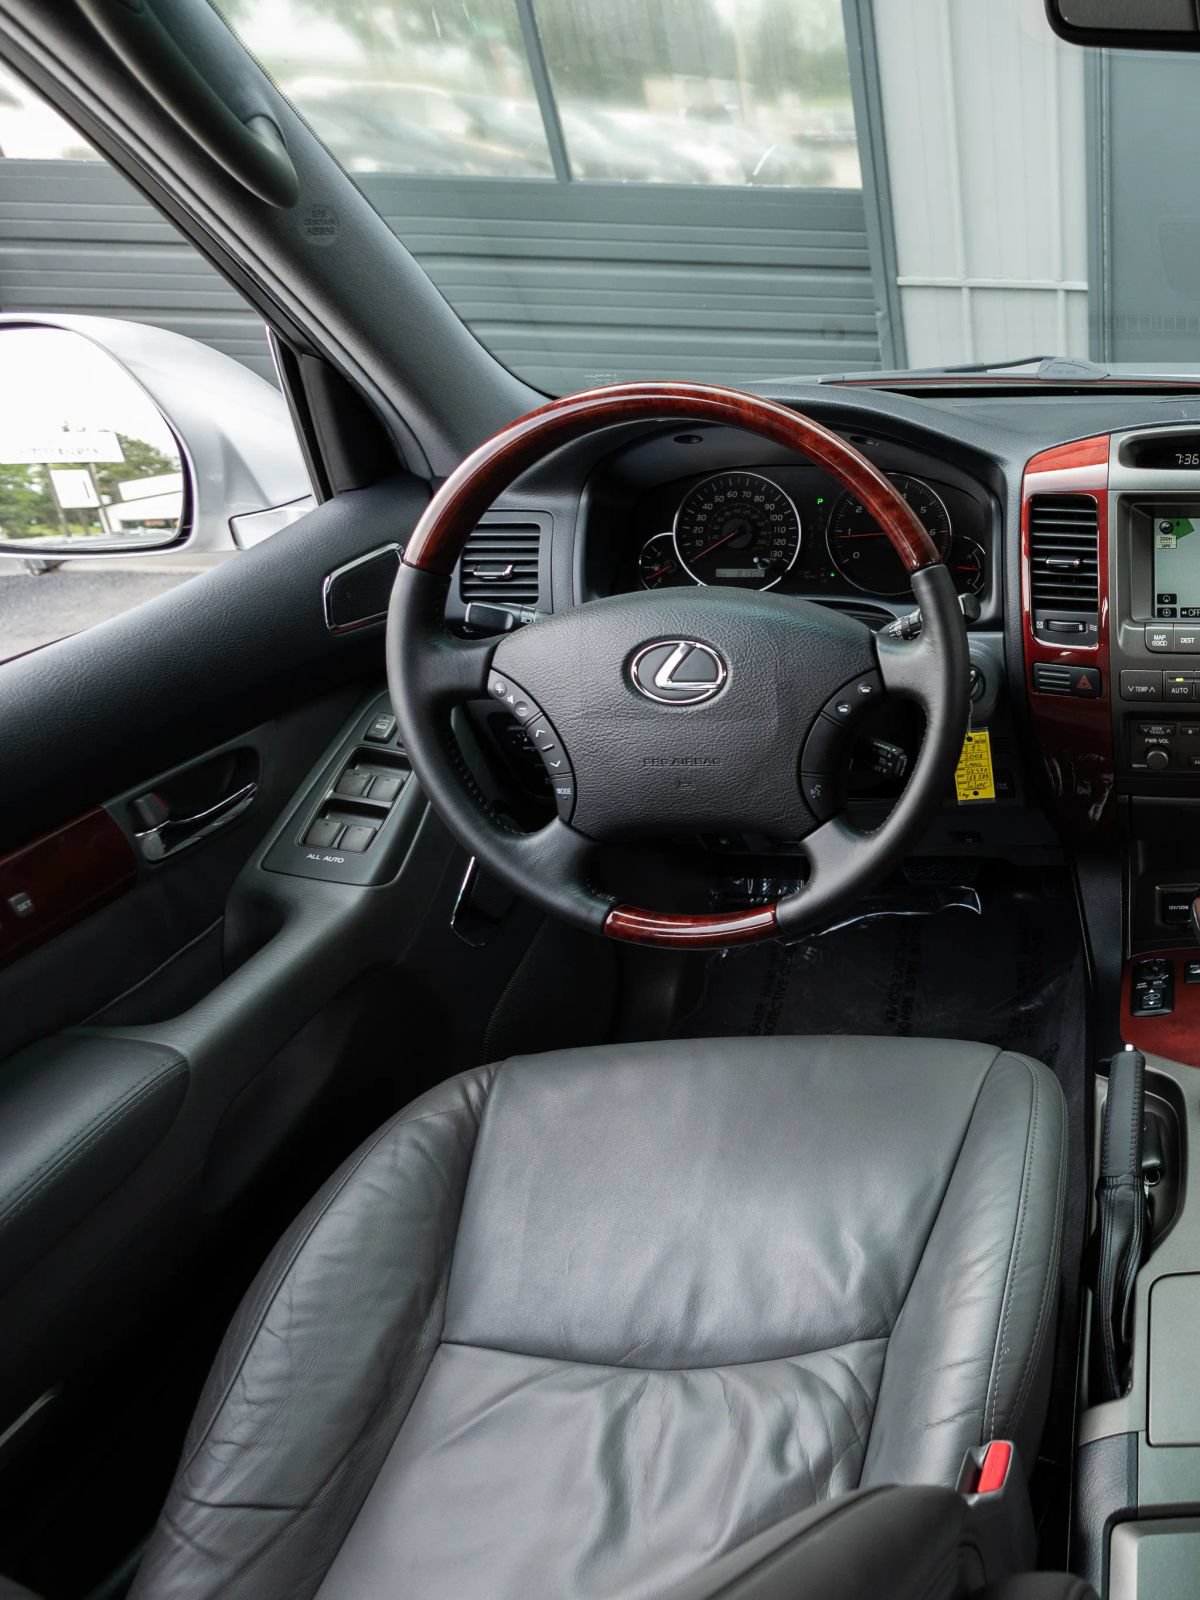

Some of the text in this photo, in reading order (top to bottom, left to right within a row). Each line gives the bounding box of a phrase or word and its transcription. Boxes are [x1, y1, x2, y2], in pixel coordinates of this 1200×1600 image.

[1176, 454, 1200, 464] 7:36
[1188, 608, 1200, 616] OFF
[323, 855, 344, 864] AUTO
